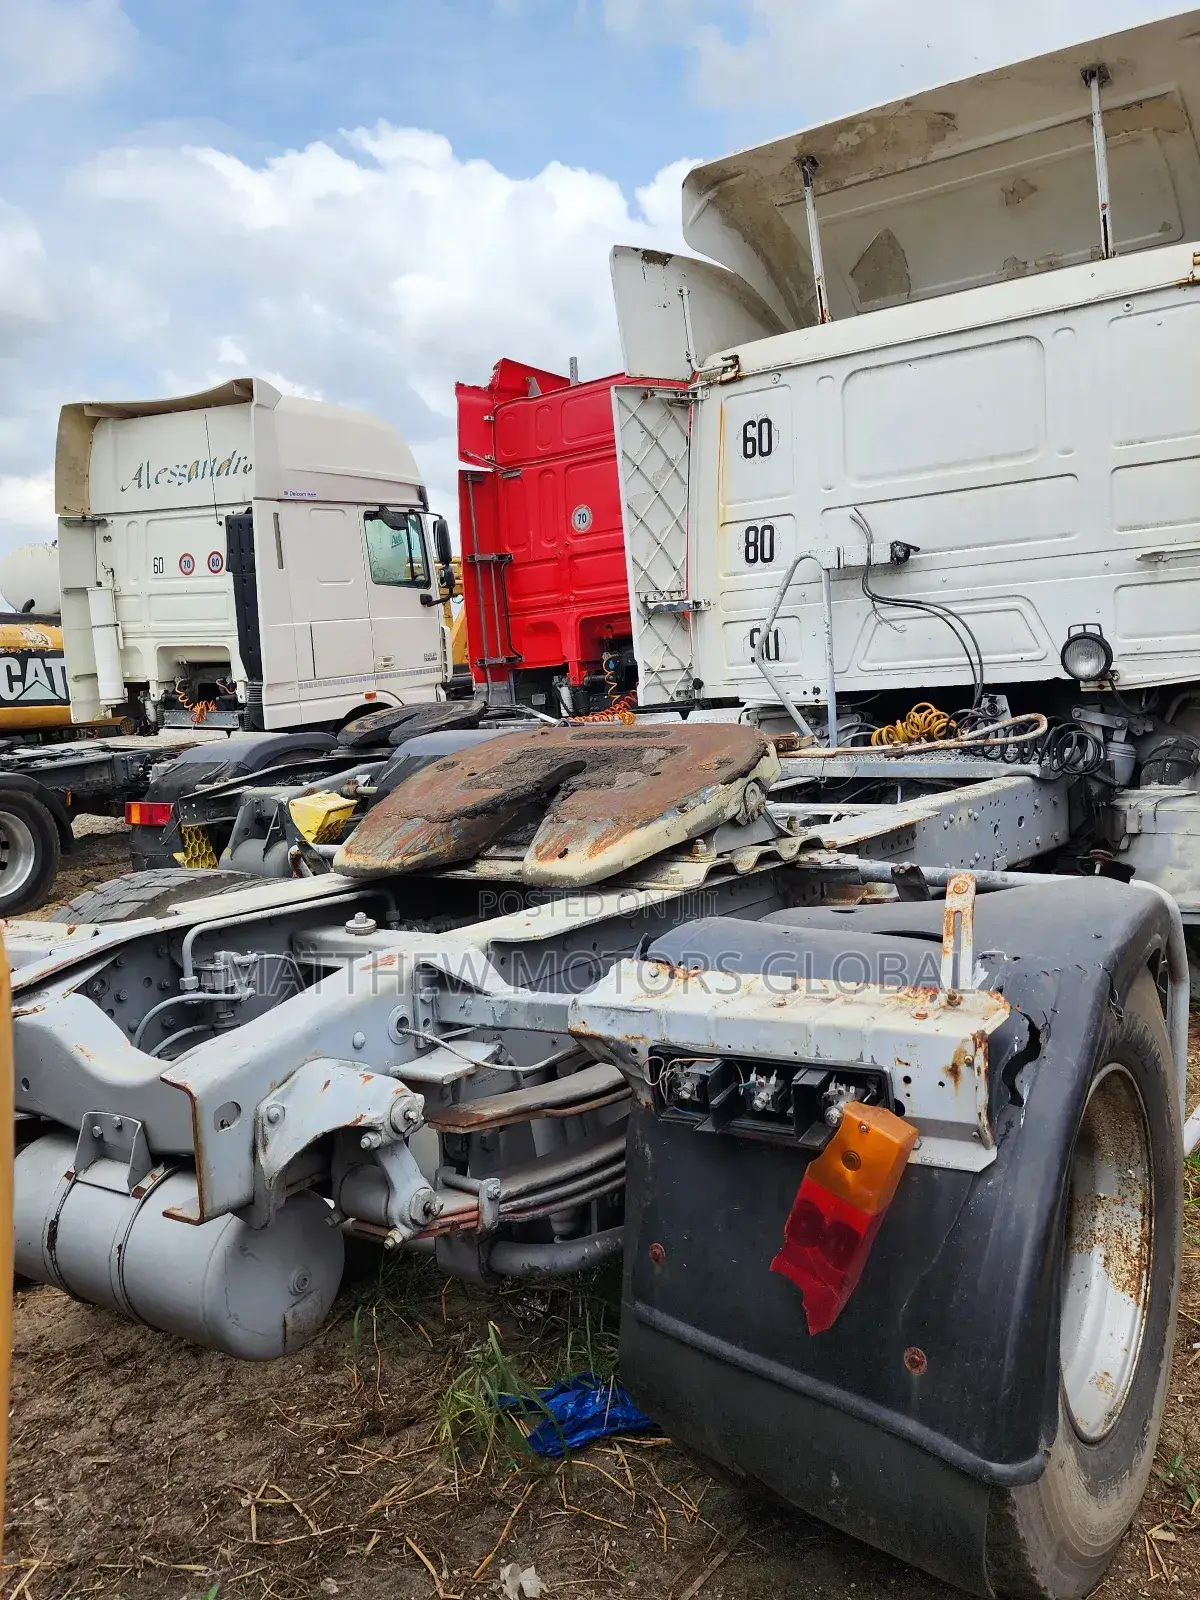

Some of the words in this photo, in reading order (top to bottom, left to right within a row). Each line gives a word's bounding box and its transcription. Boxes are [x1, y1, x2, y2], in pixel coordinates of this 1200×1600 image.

[742, 417, 773, 459] 60
[120, 449, 253, 492] Alessandro
[577, 513, 587, 525] 70
[744, 524, 775, 564] 80
[153, 556, 164, 575] 60
[183, 559, 191, 570] 70
[211, 557, 220, 568] 80
[0, 656, 69, 701] CAT
